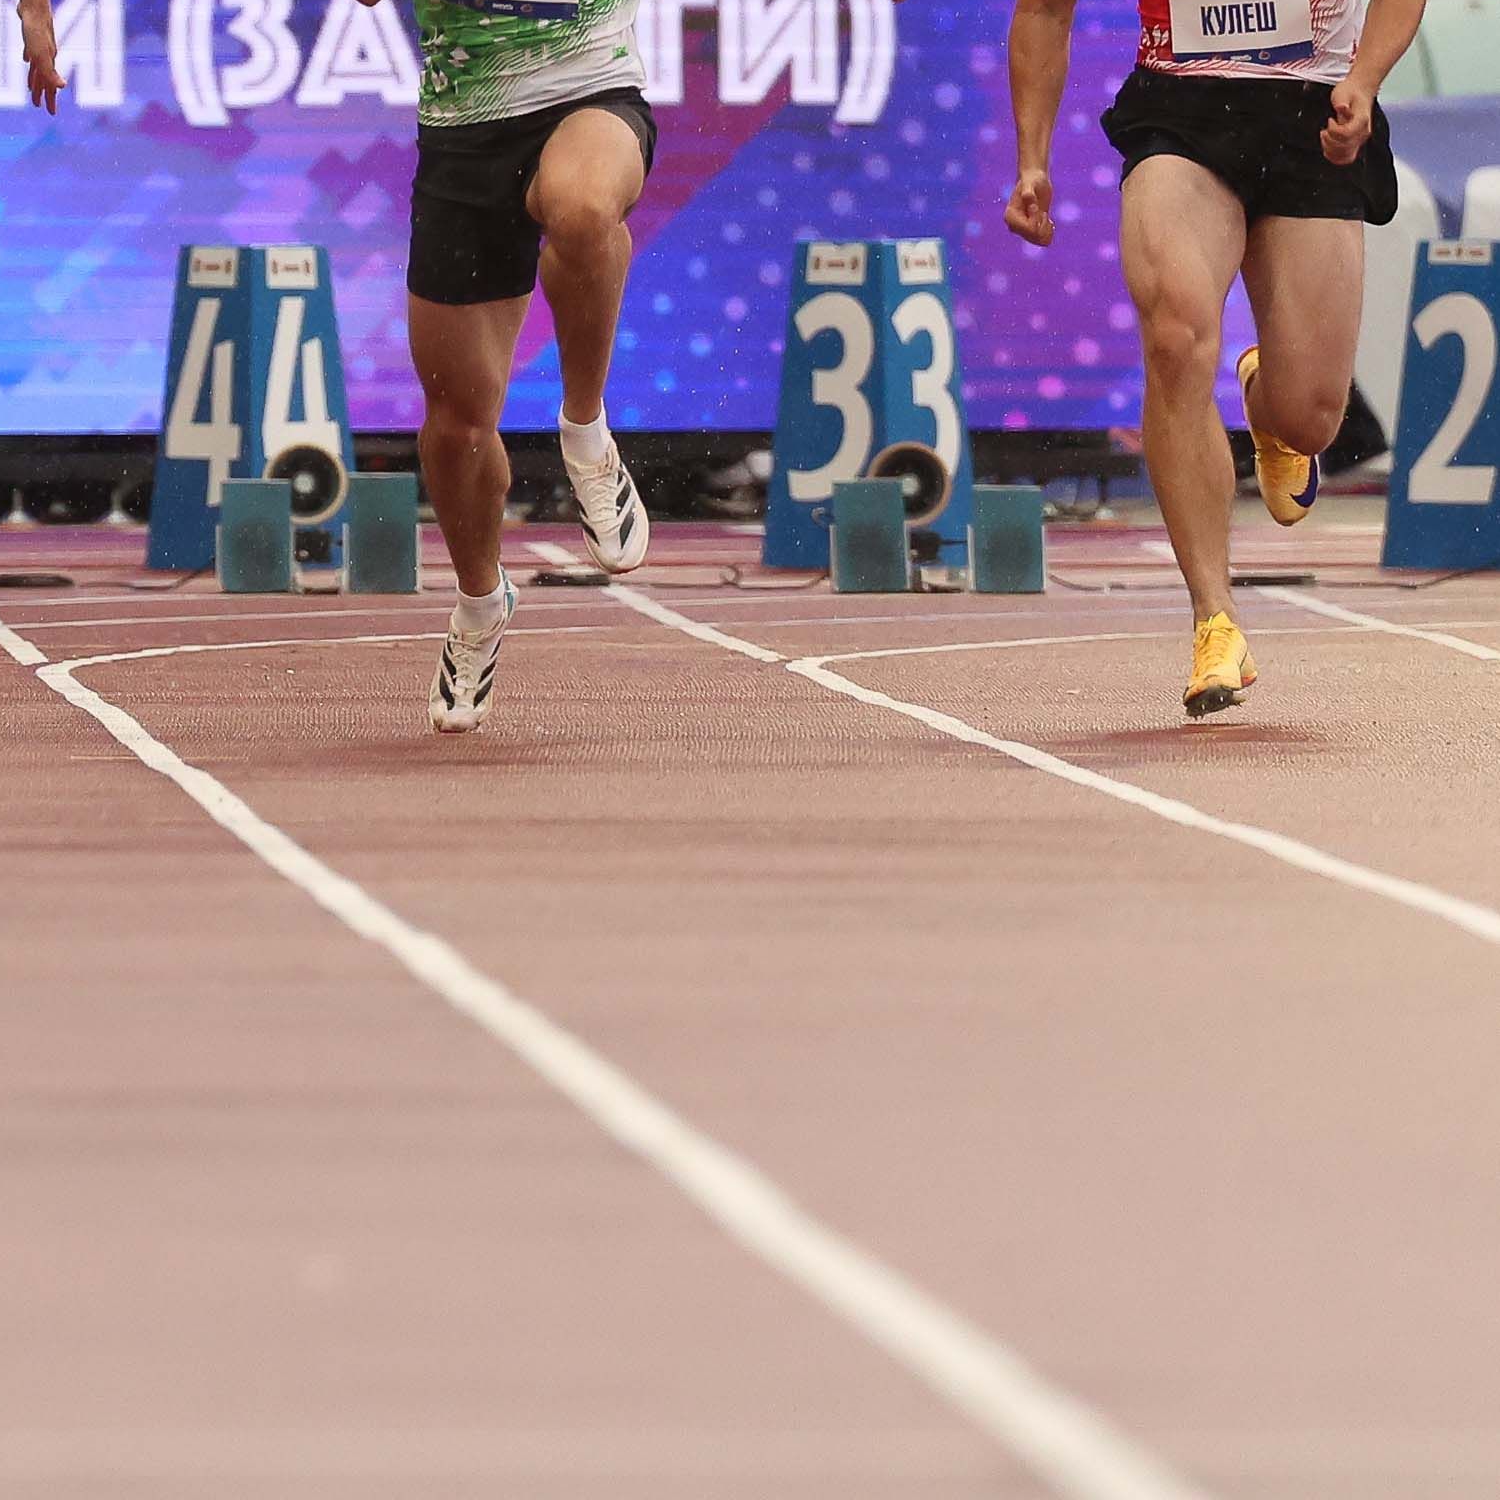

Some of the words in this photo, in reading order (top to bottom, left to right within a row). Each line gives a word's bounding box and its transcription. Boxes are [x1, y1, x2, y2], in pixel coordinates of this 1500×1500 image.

[1200, 1, 1277, 36] КУЛЕШ
[165, 296, 243, 508] 4
[786, 291, 874, 502] 3
[1407, 291, 1498, 505] 2
